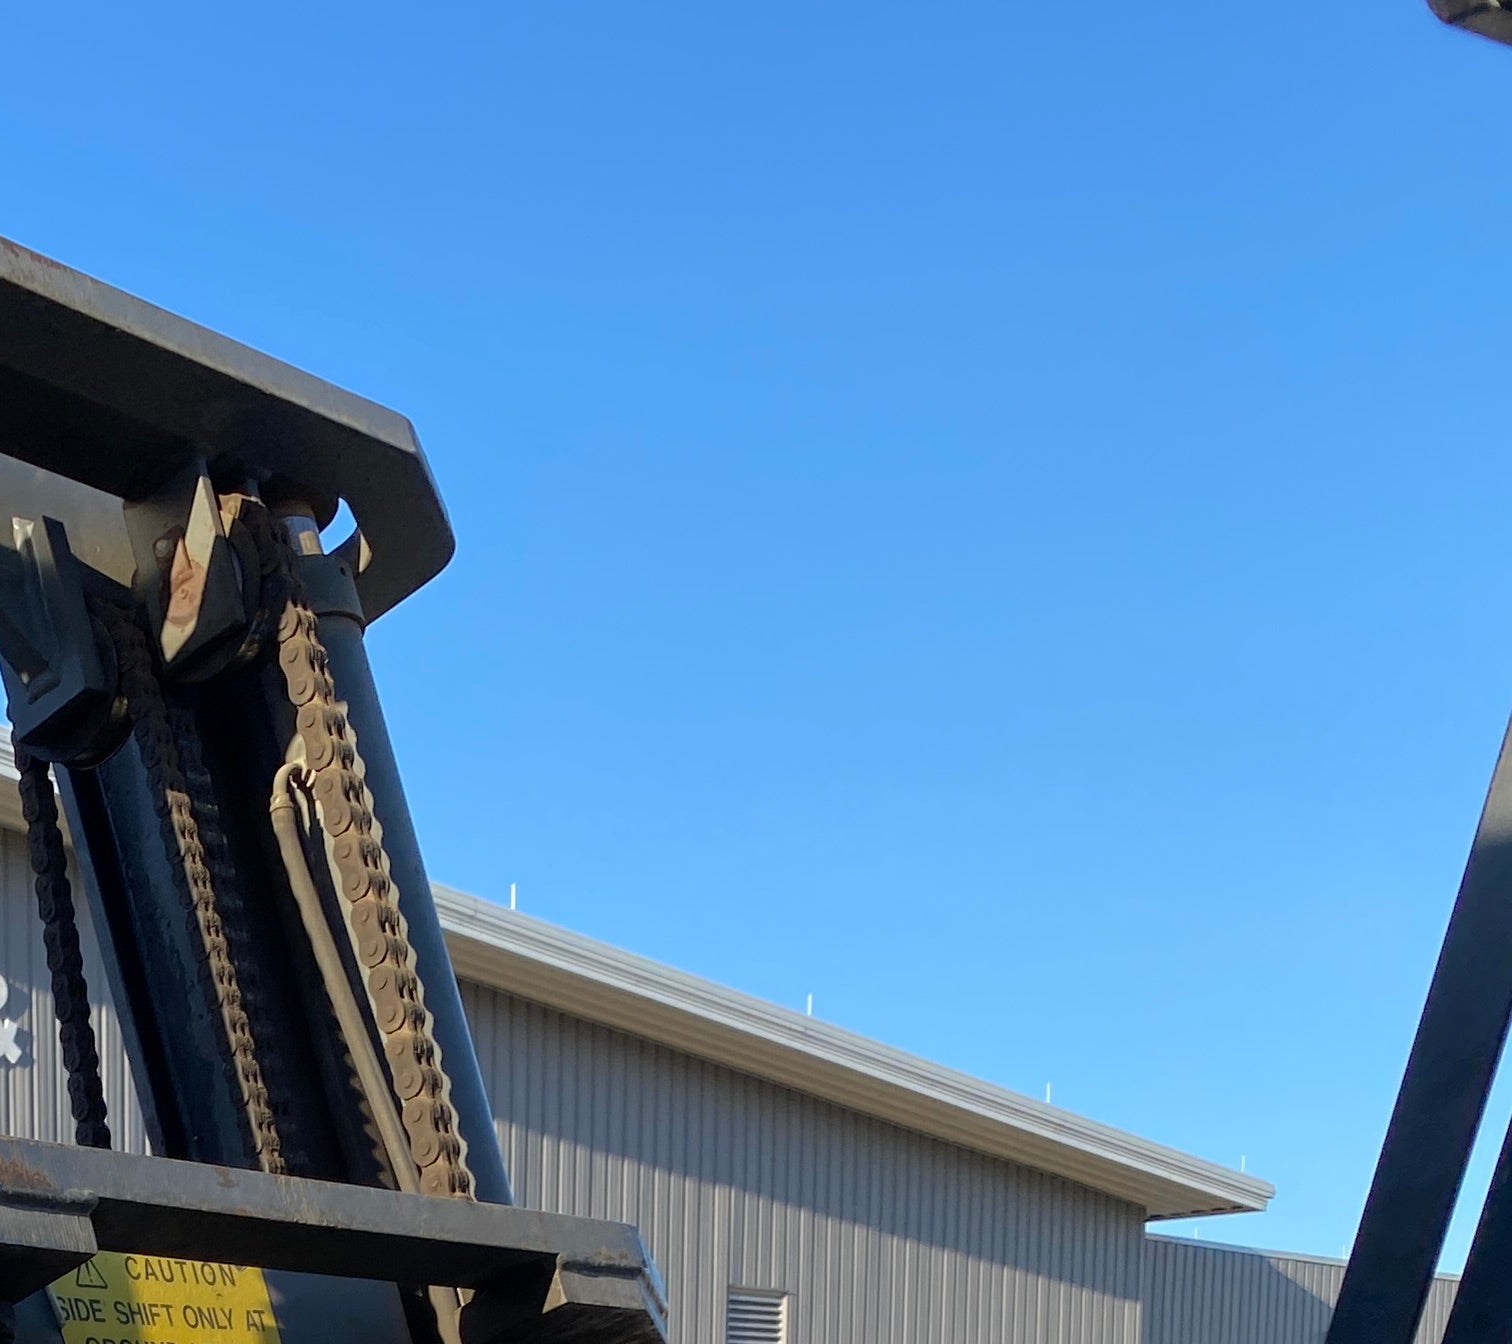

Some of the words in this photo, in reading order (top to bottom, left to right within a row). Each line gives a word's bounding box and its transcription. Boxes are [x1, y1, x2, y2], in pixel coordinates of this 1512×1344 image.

[124, 1256, 237, 1286] CAUTION
[56, 1296, 106, 1323] SIDE
[114, 1301, 174, 1328] SHIFT
[182, 1305, 235, 1330] ONLY
[246, 1309, 268, 1332] AT
